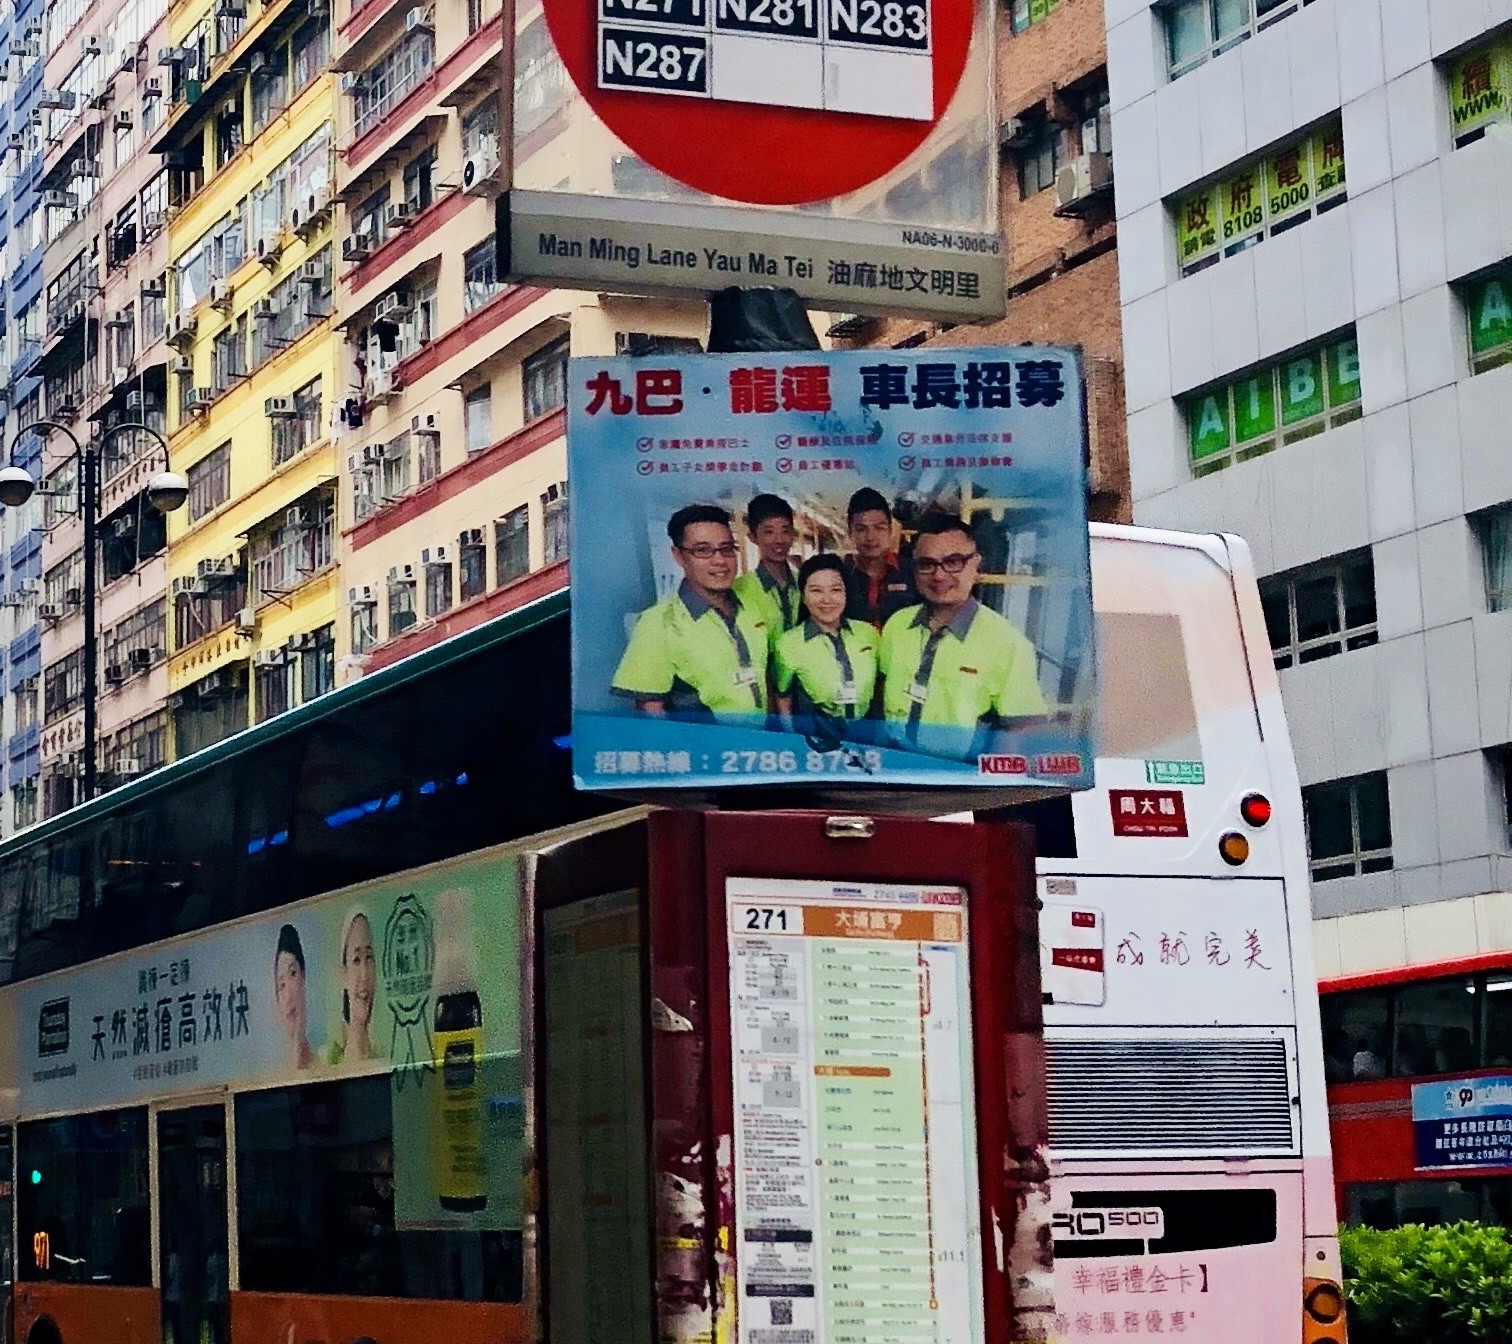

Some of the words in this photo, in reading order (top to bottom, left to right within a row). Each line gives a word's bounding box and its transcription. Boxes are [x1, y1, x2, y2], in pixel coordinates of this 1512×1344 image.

[605, 38, 704, 84] N287
[1223, 206, 1263, 238] 8108
[1271, 182, 1309, 215] 5000
[539, 234, 582, 260] Man
[589, 238, 640, 268] Ming
[647, 246, 697, 269] Lane
[703, 249, 742, 274] Yau
[748, 254, 779, 277] Ma
[783, 257, 814, 280] Tei
[827, 259, 980, 299] 油麻地文明里
[860, 360, 1064, 411] 車長招募
[721, 750, 797, 773] 2786
[745, 908, 788, 931] 271
